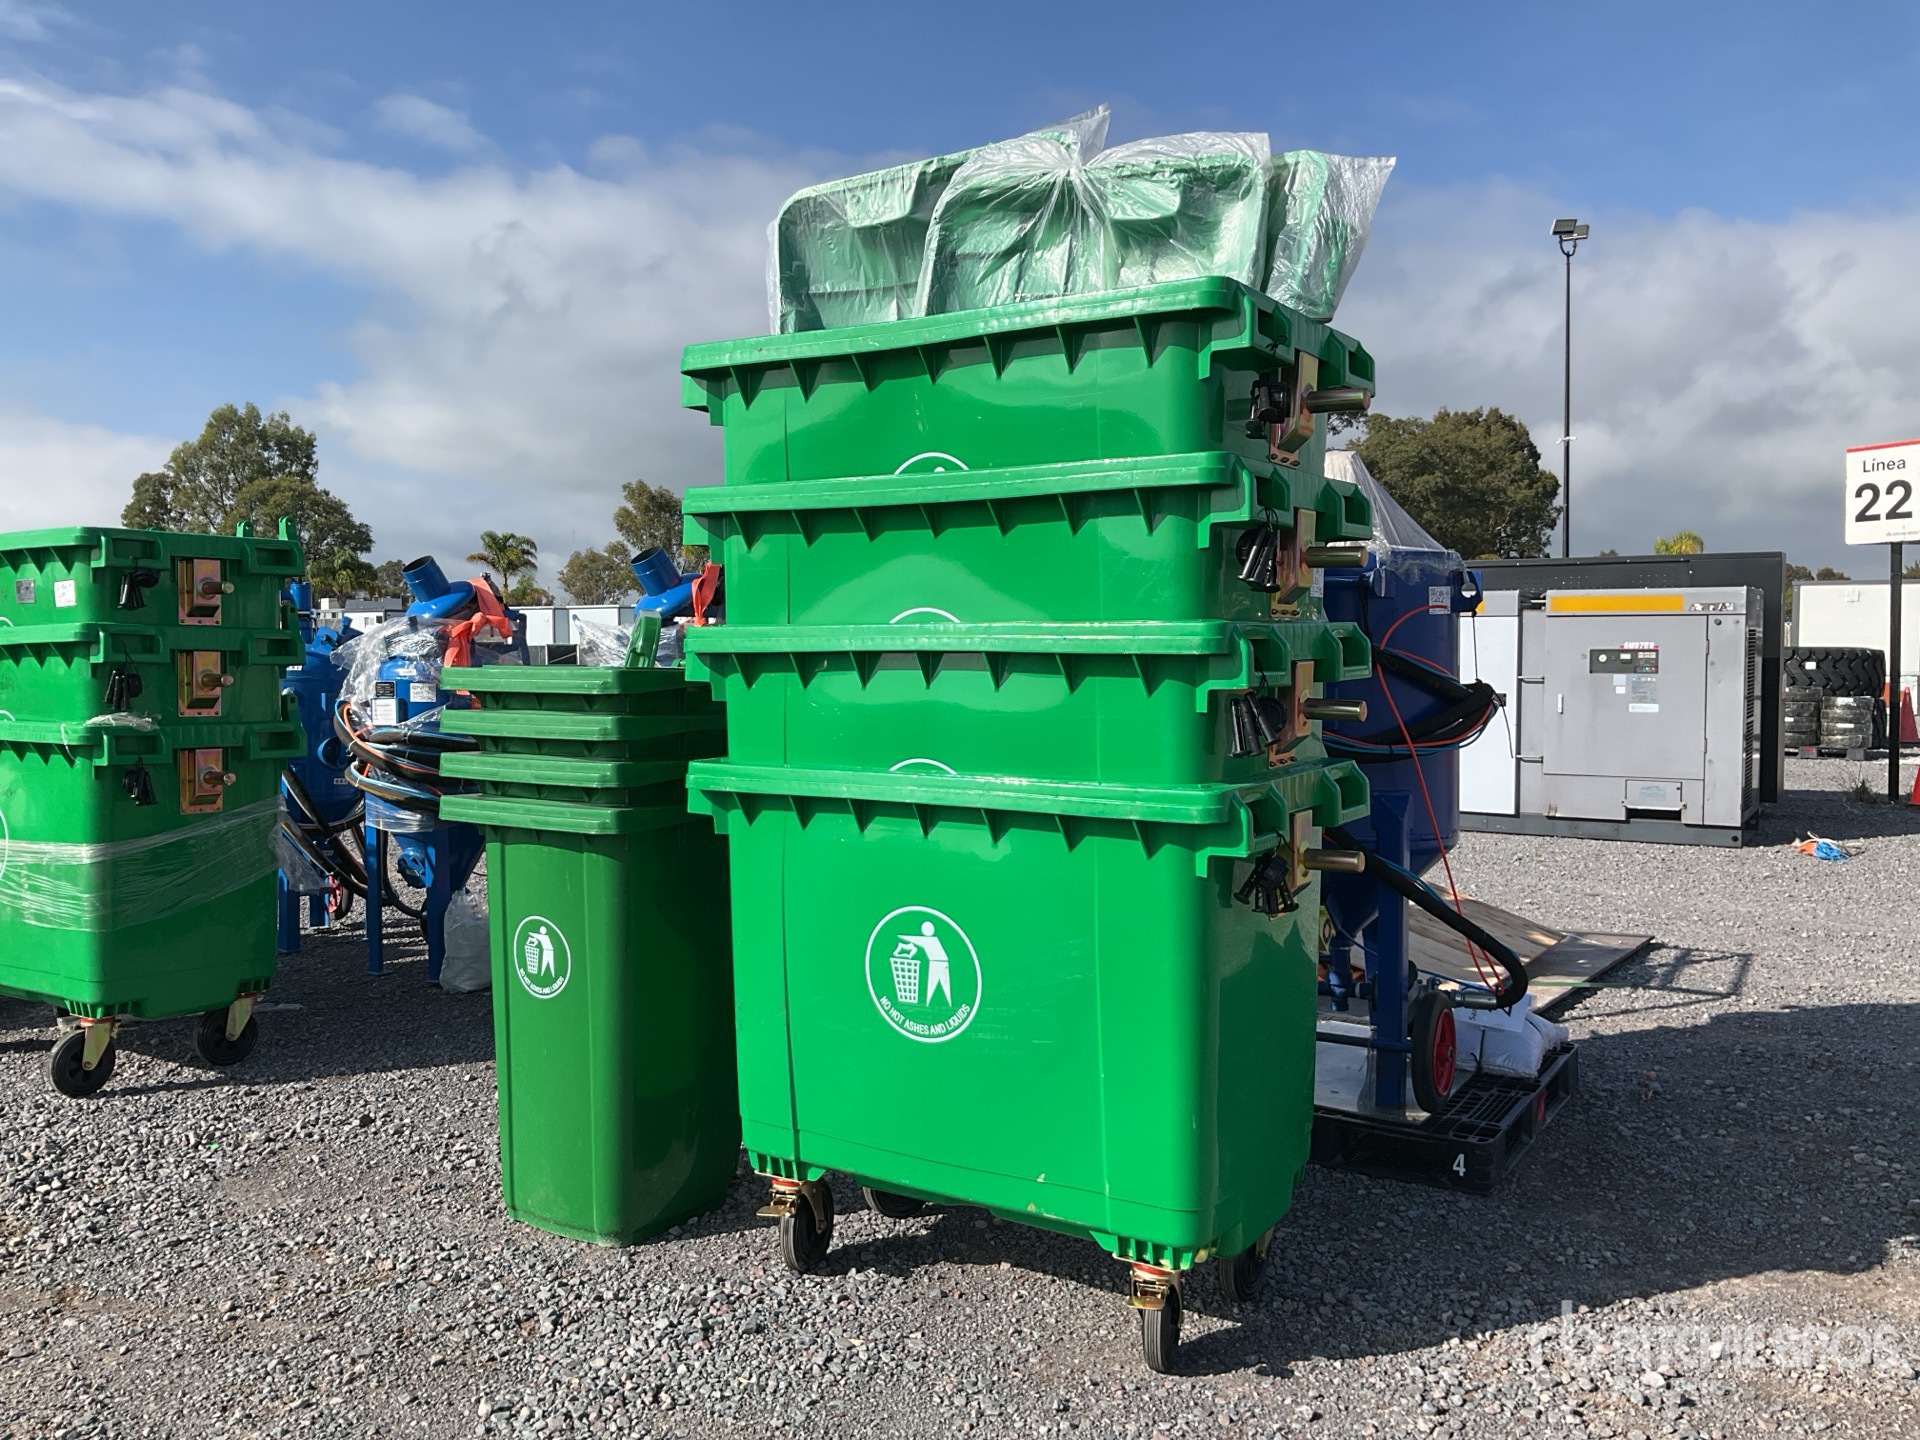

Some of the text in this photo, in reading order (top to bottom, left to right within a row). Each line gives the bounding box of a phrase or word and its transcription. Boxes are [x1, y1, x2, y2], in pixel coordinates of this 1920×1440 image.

[1862, 458, 1906, 473] Línea
[1855, 479, 1913, 523] 22
[880, 995, 971, 1035] NO HOT ASHES AND LIQUIDS
[1452, 1152, 1466, 1177] 4
